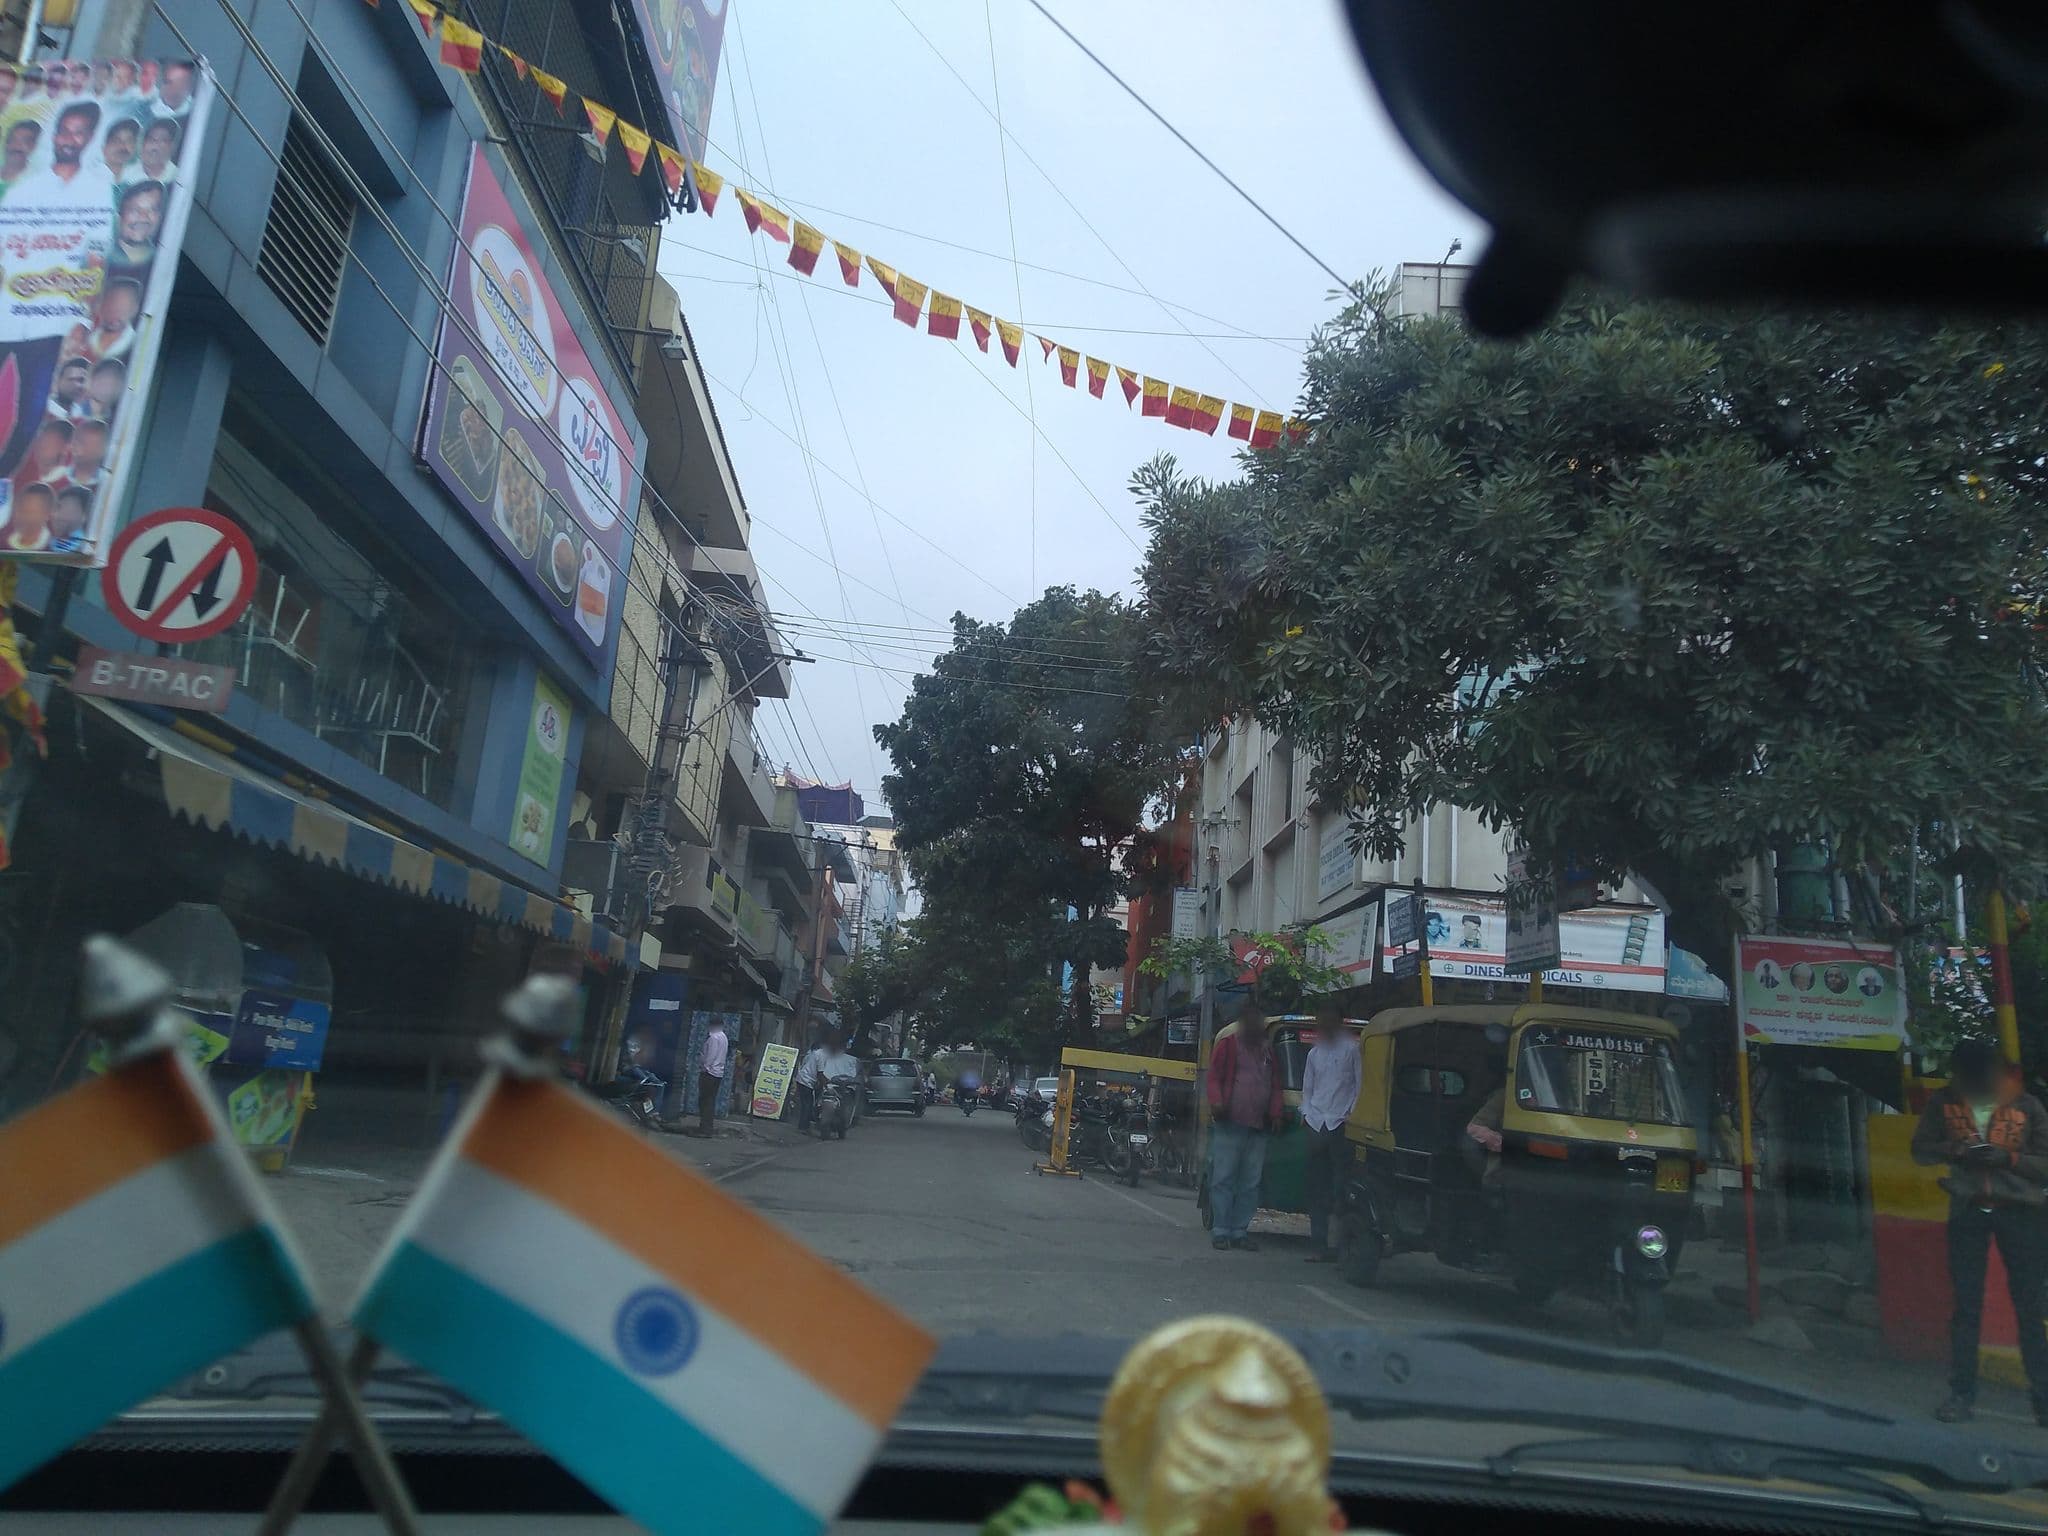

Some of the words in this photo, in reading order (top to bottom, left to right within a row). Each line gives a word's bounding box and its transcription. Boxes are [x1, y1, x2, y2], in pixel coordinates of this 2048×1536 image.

[89, 659, 216, 700] B-TRAC
[1516, 970, 1583, 984] MDICALS
[1566, 1034, 1645, 1054] JAGADISH
